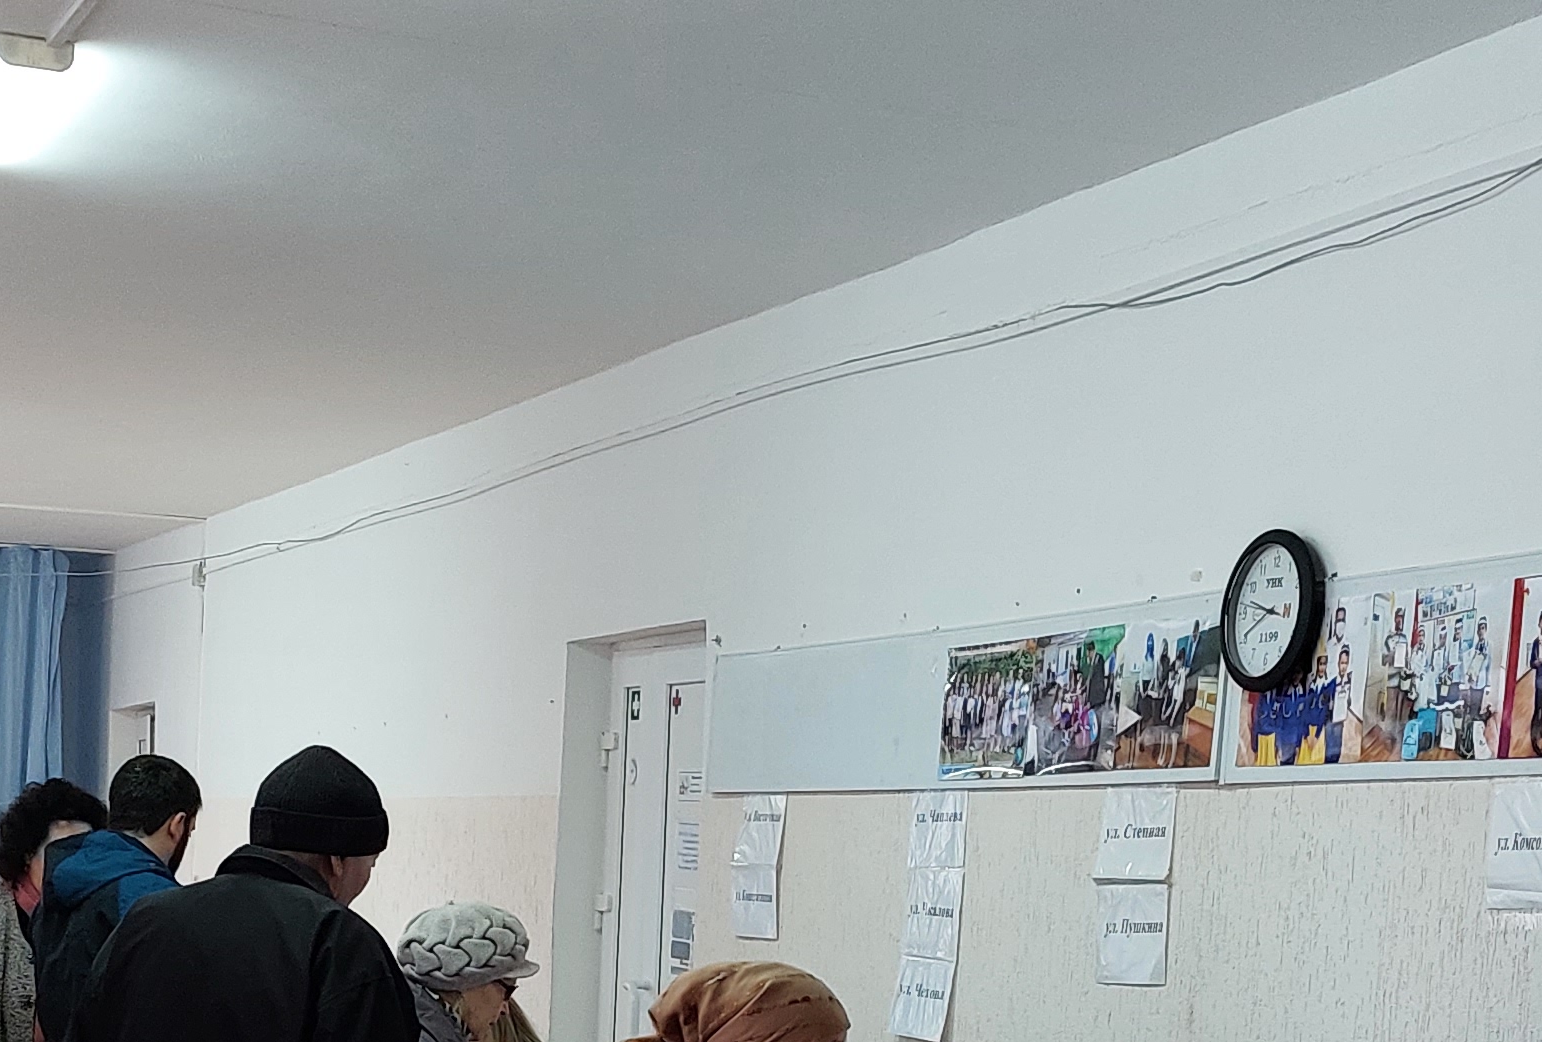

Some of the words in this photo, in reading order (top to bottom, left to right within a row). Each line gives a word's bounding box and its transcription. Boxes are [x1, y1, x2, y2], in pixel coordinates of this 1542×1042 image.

[1260, 563, 1267, 576] 11
[1274, 555, 1282, 568] 12
[1259, 631, 1279, 644] 1199
[1103, 827, 1120, 844] ул.
[1123, 823, 1167, 840] Степная
[1493, 837, 1510, 857] ул.
[1103, 921, 1119, 939] ул.
[1119, 918, 1164, 939] Пушкина
